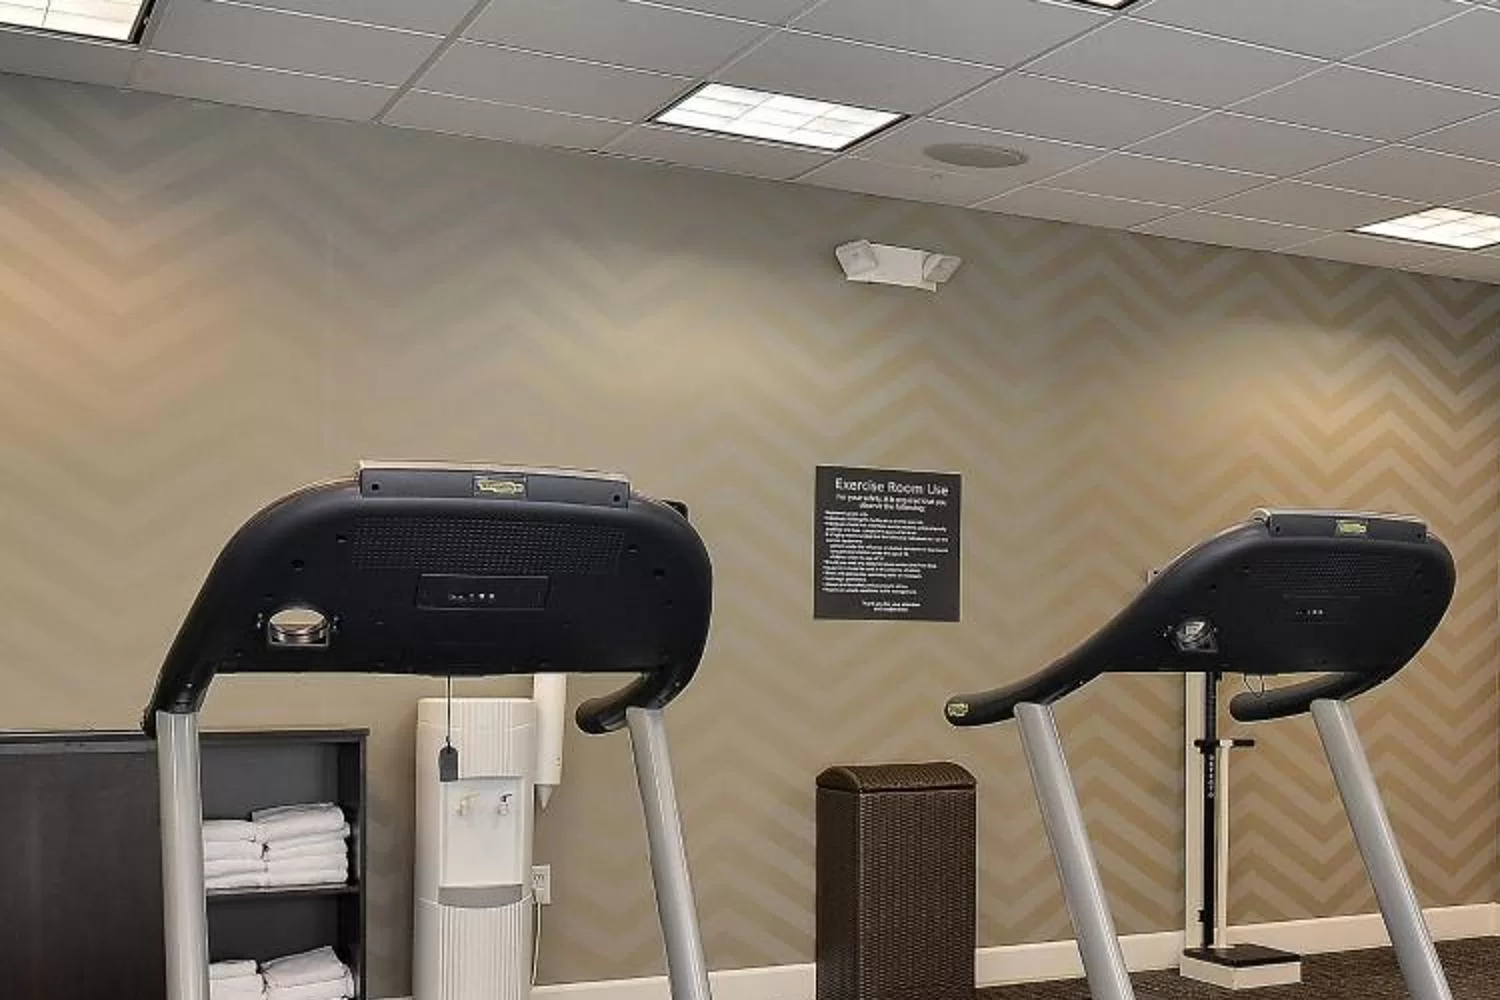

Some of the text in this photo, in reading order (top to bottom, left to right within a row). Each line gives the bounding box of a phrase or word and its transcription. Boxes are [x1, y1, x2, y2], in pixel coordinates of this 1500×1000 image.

[835, 477, 950, 497] Exercise Room Use
